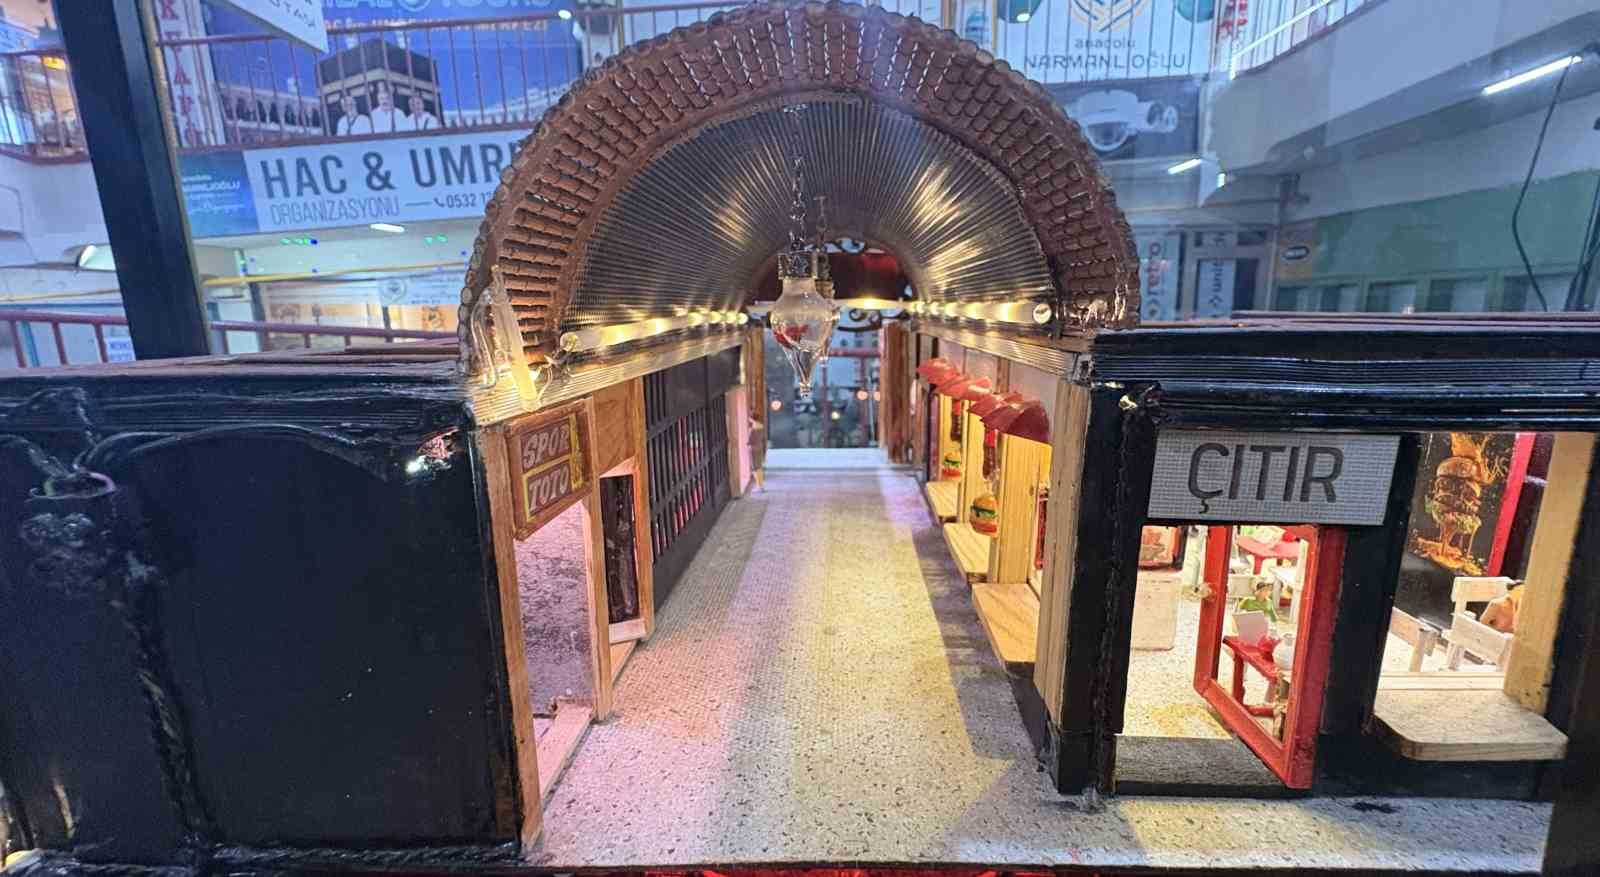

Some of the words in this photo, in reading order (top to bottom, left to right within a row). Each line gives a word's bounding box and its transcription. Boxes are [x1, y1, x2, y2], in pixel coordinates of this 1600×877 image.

[1025, 51, 1186, 70] NARMANLOĞLU
[260, 154, 347, 199] HAC
[362, 151, 397, 192] &
[446, 193, 477, 210] 0532
[523, 424, 570, 468] SPOR
[528, 465, 570, 514] TOTO
[1188, 442, 1344, 514] ÇITIR
